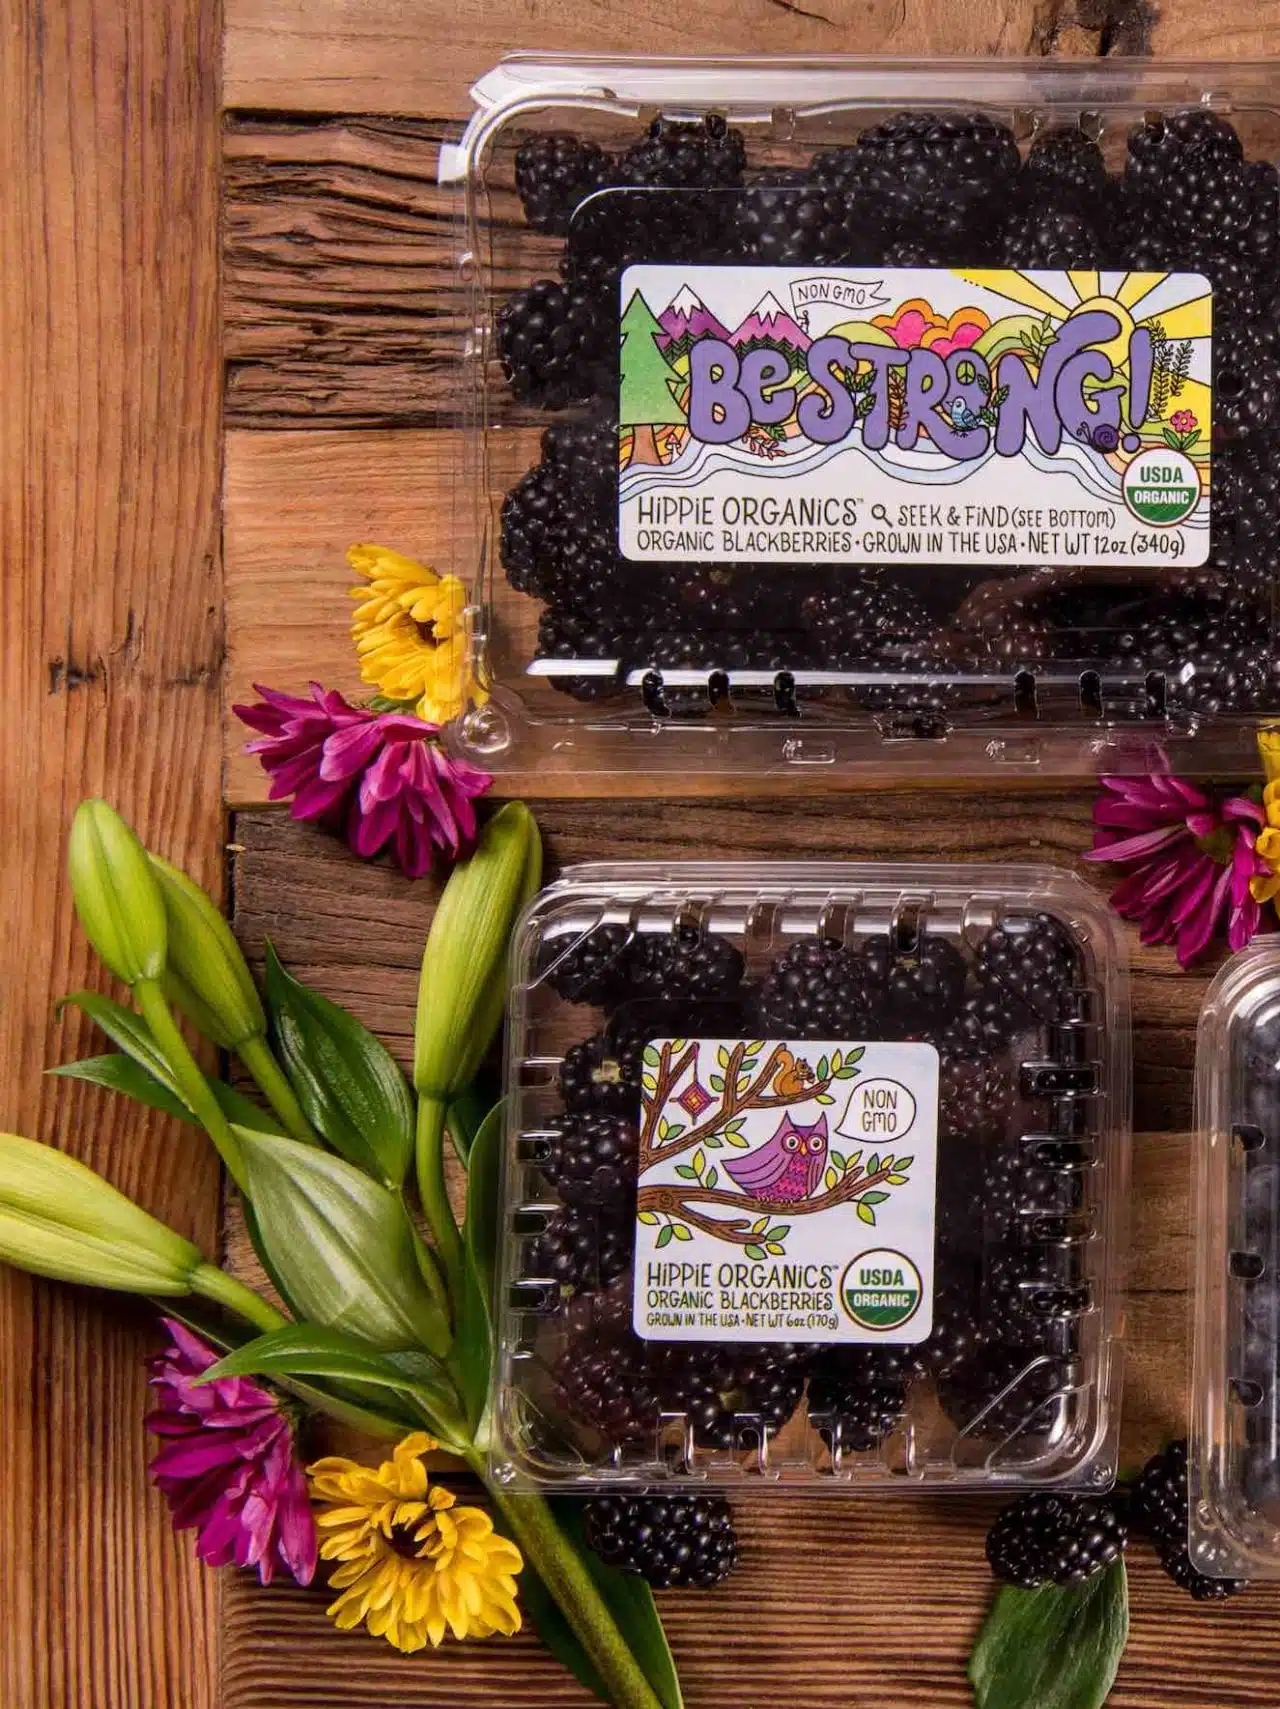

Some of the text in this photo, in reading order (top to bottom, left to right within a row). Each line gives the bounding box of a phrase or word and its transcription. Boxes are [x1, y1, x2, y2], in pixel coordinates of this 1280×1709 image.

[798, 283, 830, 300] NON
[1140, 466, 1184, 484] USDA
[1134, 490, 1190, 505] ORGANIC
[899, 504, 942, 527] SEEK
[947, 507, 961, 526] &
[863, 531, 922, 553] GROWN
[926, 532, 943, 552] IN
[948, 532, 980, 553] THE
[985, 532, 1017, 554] USA
[1028, 533, 1060, 555] NET
[1064, 533, 1091, 555] WT
[1130, 531, 1185, 560] (340g)
[863, 1089, 897, 1109] NON
[861, 1111, 897, 1133] GMO
[859, 1268, 905, 1286] USDA
[853, 1292, 911, 1307] ORGANIC
[646, 1312, 682, 1327] GROWN
[699, 1313, 717, 1327] THE
[721, 1313, 740, 1327] USA
[745, 1313, 766, 1328] NET
[767, 1313, 785, 1328] WT
